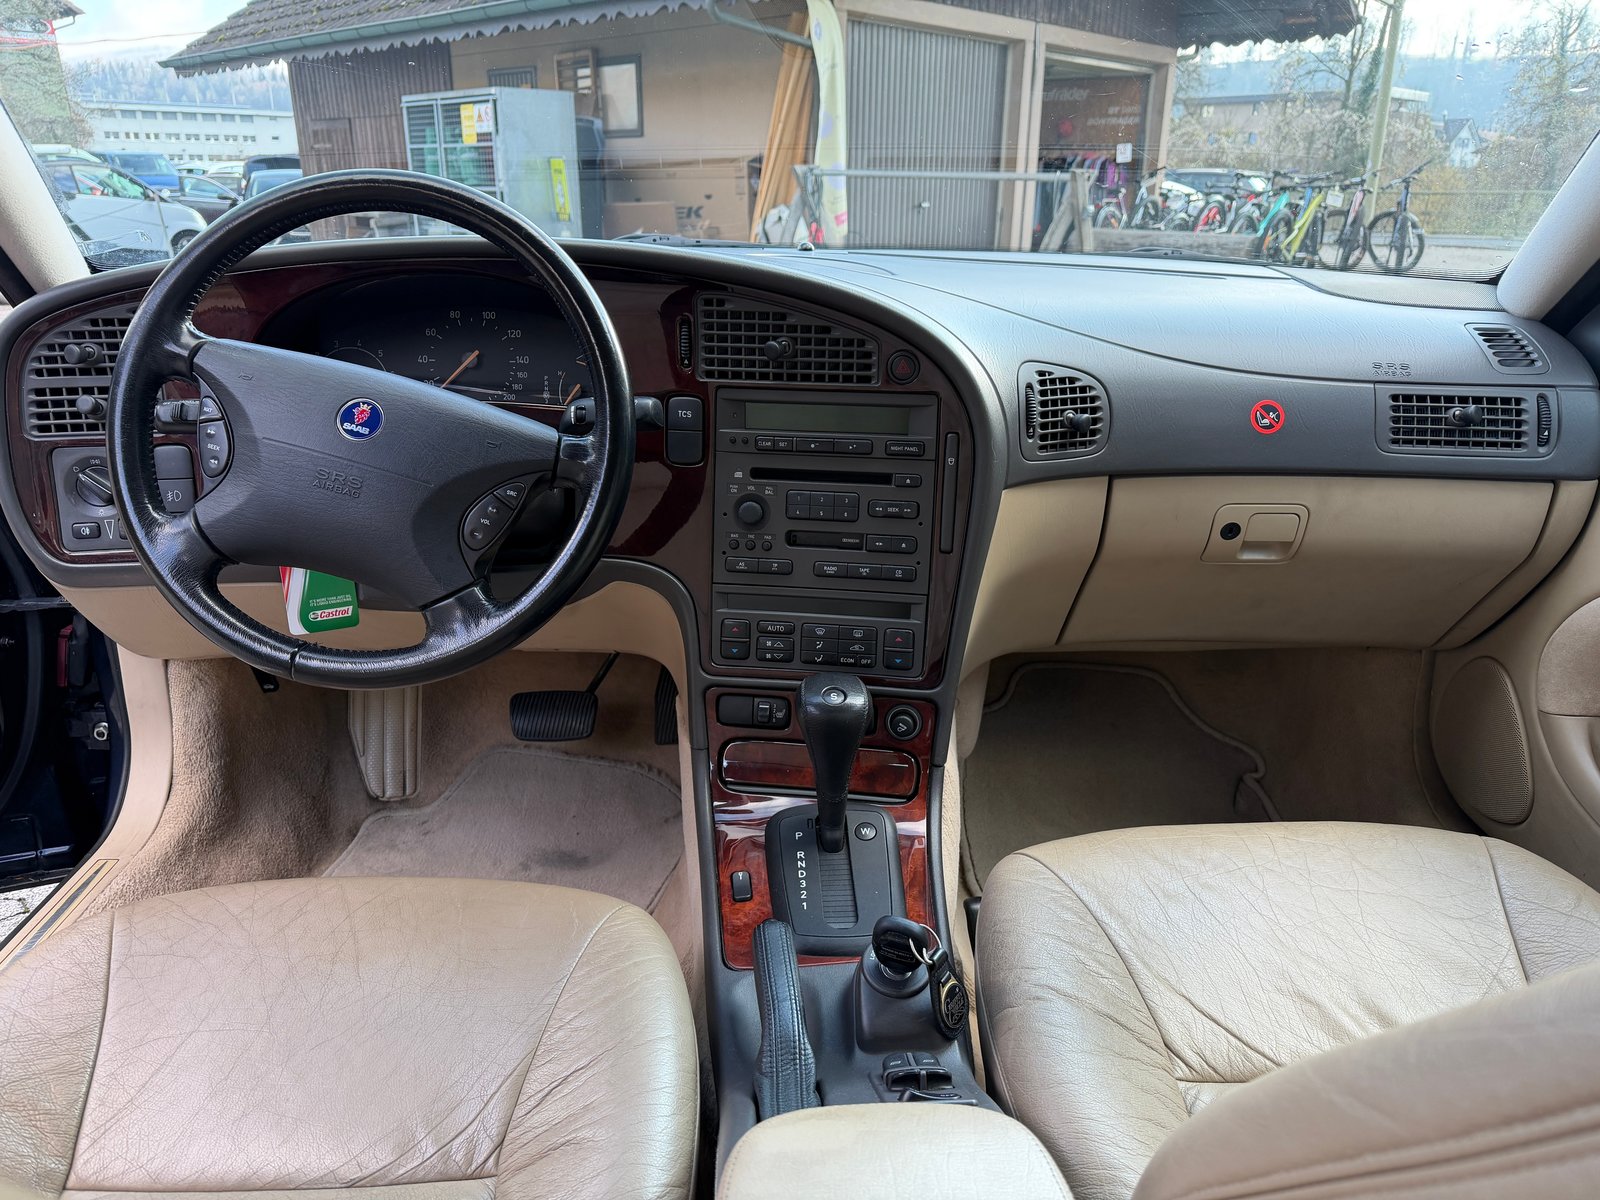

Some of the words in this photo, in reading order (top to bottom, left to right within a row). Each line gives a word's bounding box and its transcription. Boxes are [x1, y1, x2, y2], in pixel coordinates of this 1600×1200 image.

[675, 205, 704, 220] EK
[450, 310, 460, 318] 80
[482, 311, 496, 320] 100
[426, 328, 436, 336] 60
[508, 330, 522, 338] 120
[418, 355, 428, 364] 40
[516, 356, 530, 364] 140
[1372, 362, 1410, 370] SRS
[342, 422, 370, 434] SAAB
[208, 443, 220, 451] SEEK
[315, 467, 364, 490] SRS
[312, 480, 360, 498] AIRBAG
[320, 608, 350, 619] Castrol
[795, 832, 803, 840] P
[797, 851, 805, 859] R
[798, 860, 806, 868] N
[798, 870, 806, 878] D
[800, 890, 807, 898] 2
[802, 902, 807, 910] 1
